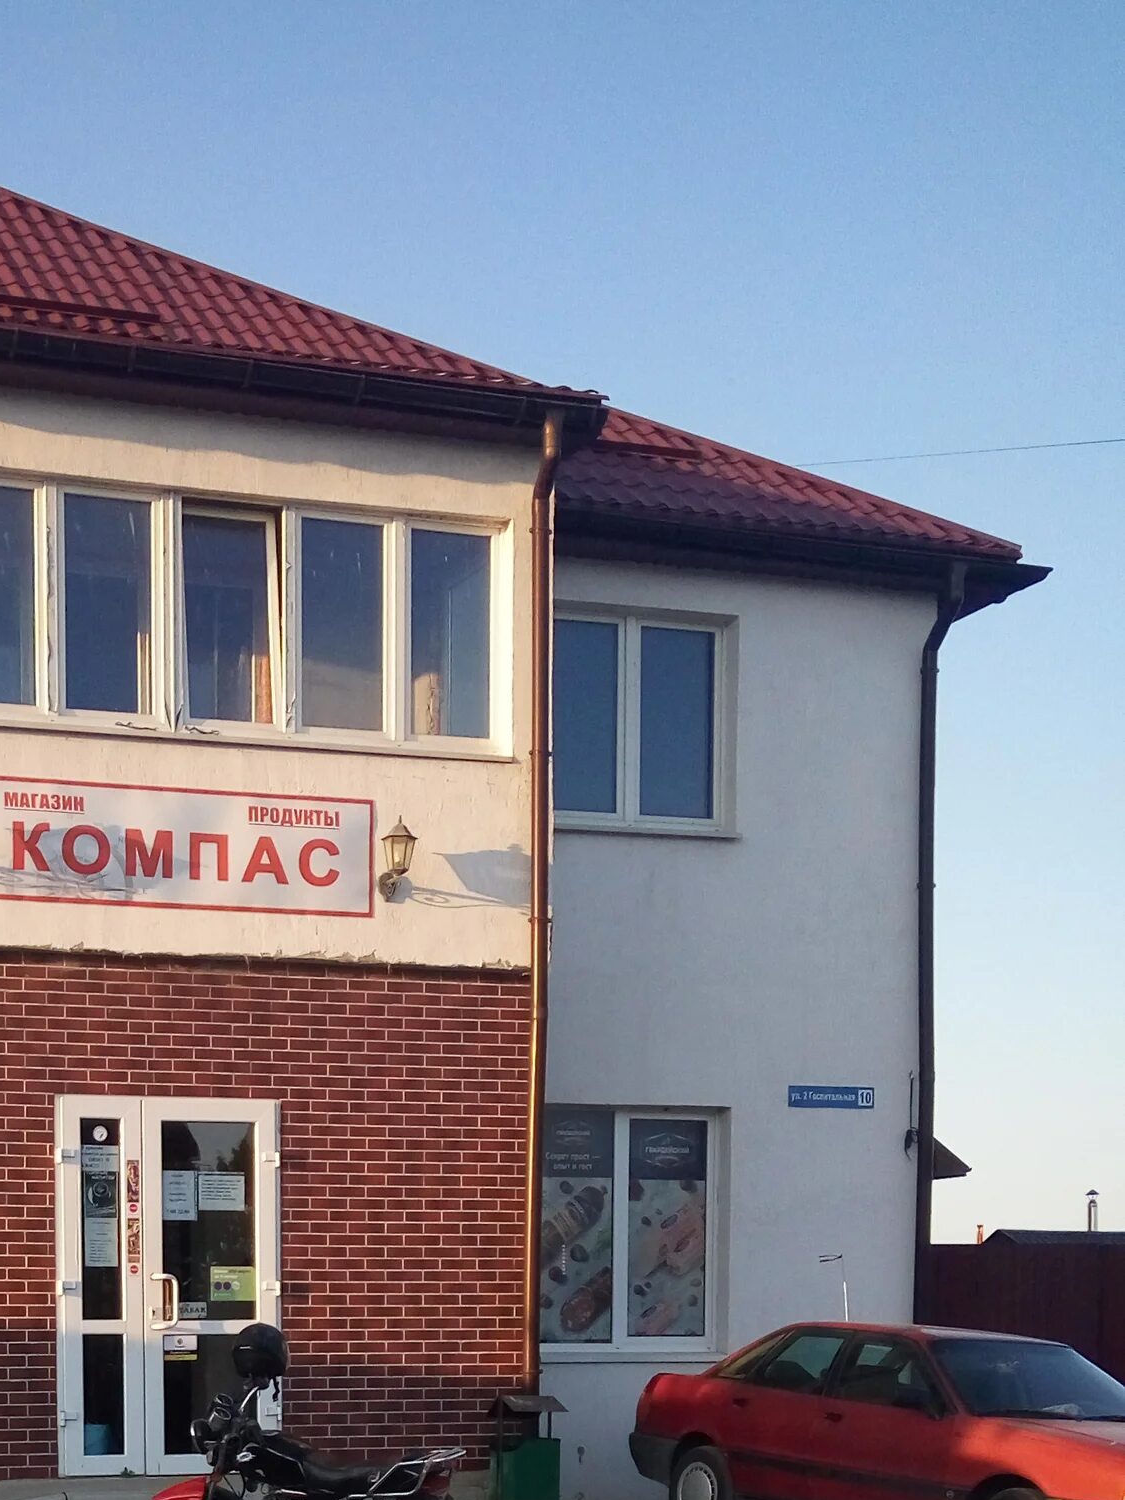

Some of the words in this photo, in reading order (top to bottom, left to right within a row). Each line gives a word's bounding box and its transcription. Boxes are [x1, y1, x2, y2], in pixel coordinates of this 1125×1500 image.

[4, 791, 84, 811] МАГАЗИН
[248, 805, 340, 828] ПРОДУКТЫ
[12, 820, 340, 887] КОМПАС
[859, 1091, 872, 1105] 10
